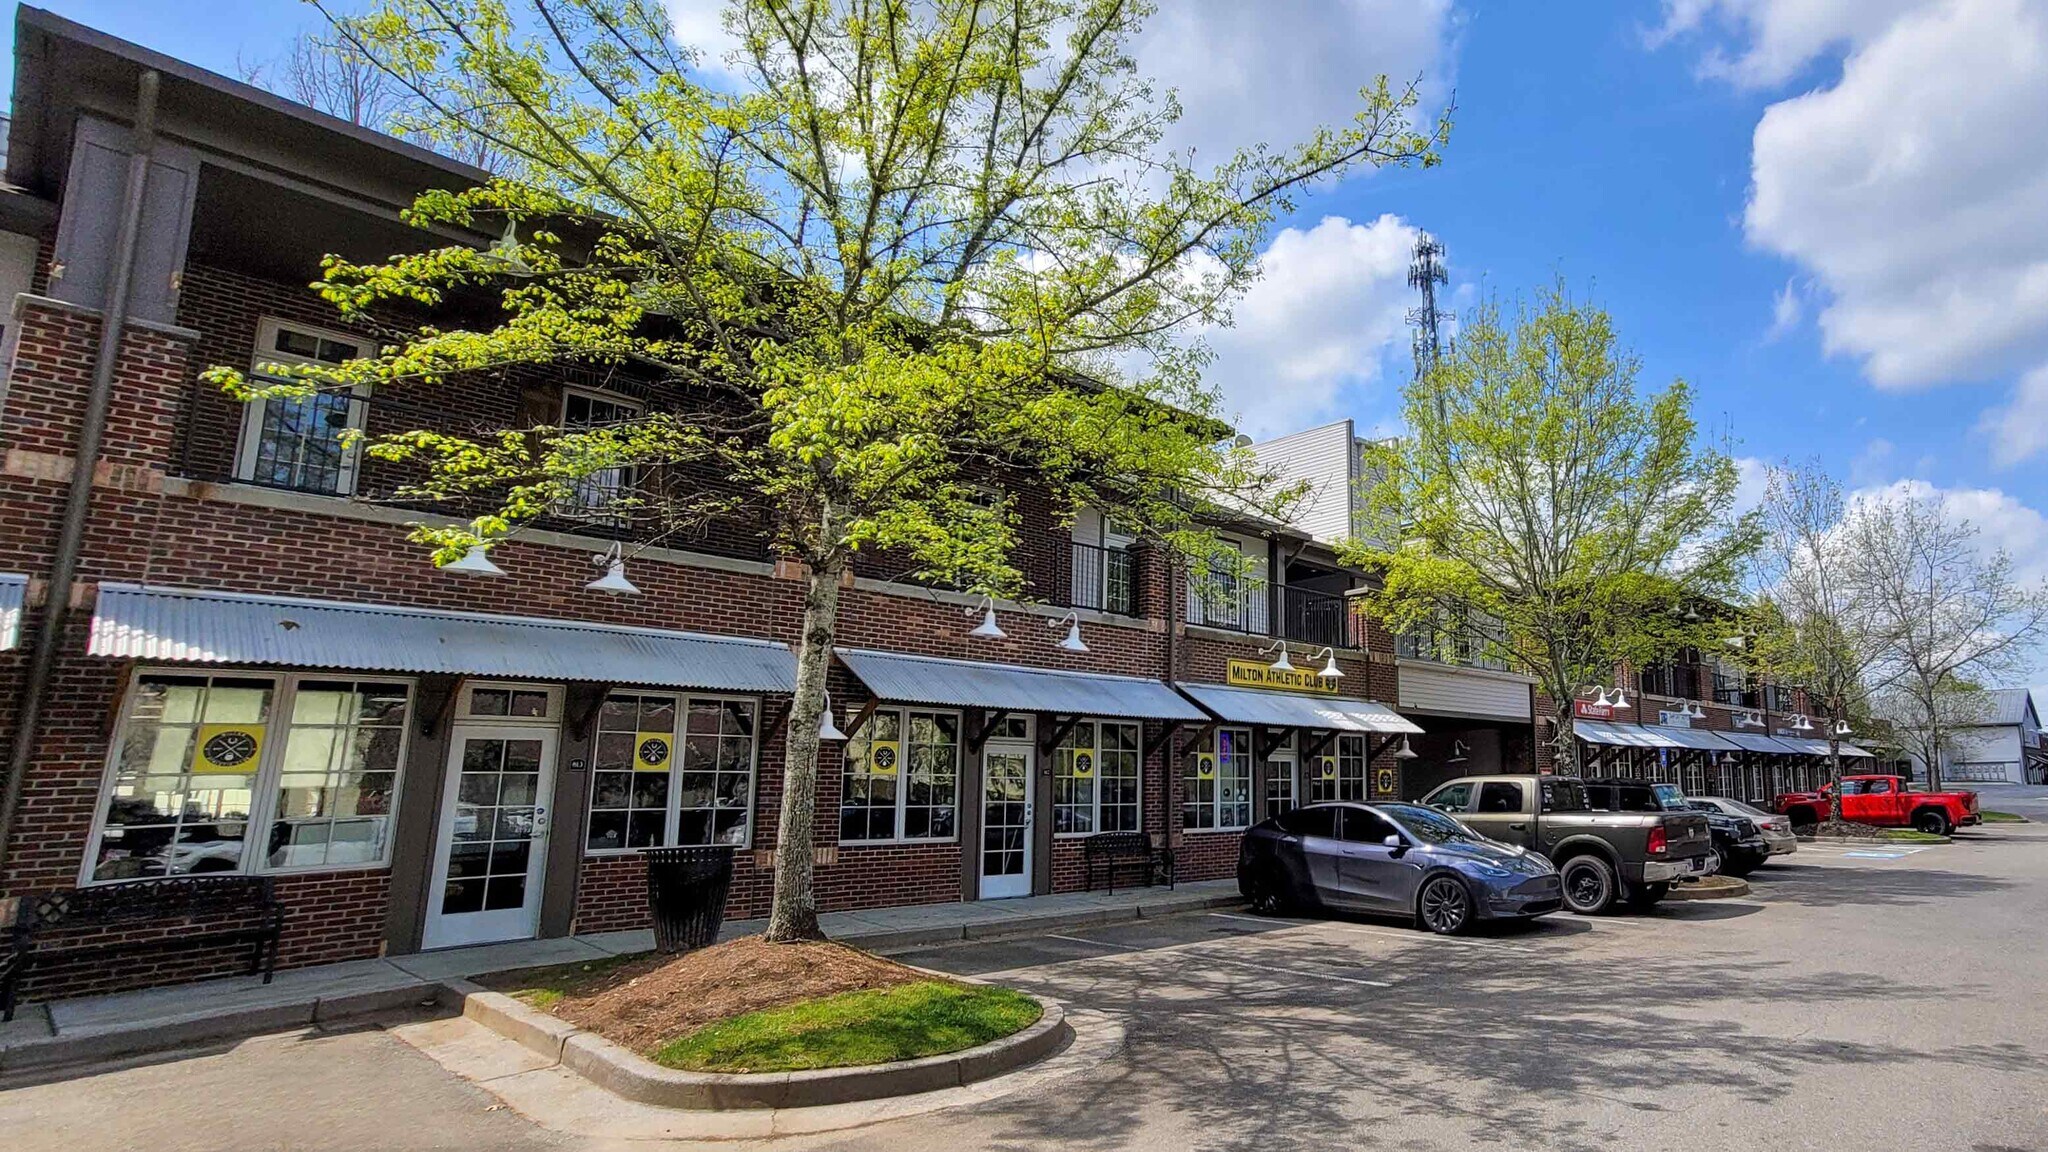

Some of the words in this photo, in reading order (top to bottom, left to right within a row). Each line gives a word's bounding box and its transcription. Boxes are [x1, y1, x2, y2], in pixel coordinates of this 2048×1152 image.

[1232, 665, 1263, 683] MILTON
[1267, 668, 1301, 686] ATHLETIC
[1304, 674, 1323, 688] CLUB
